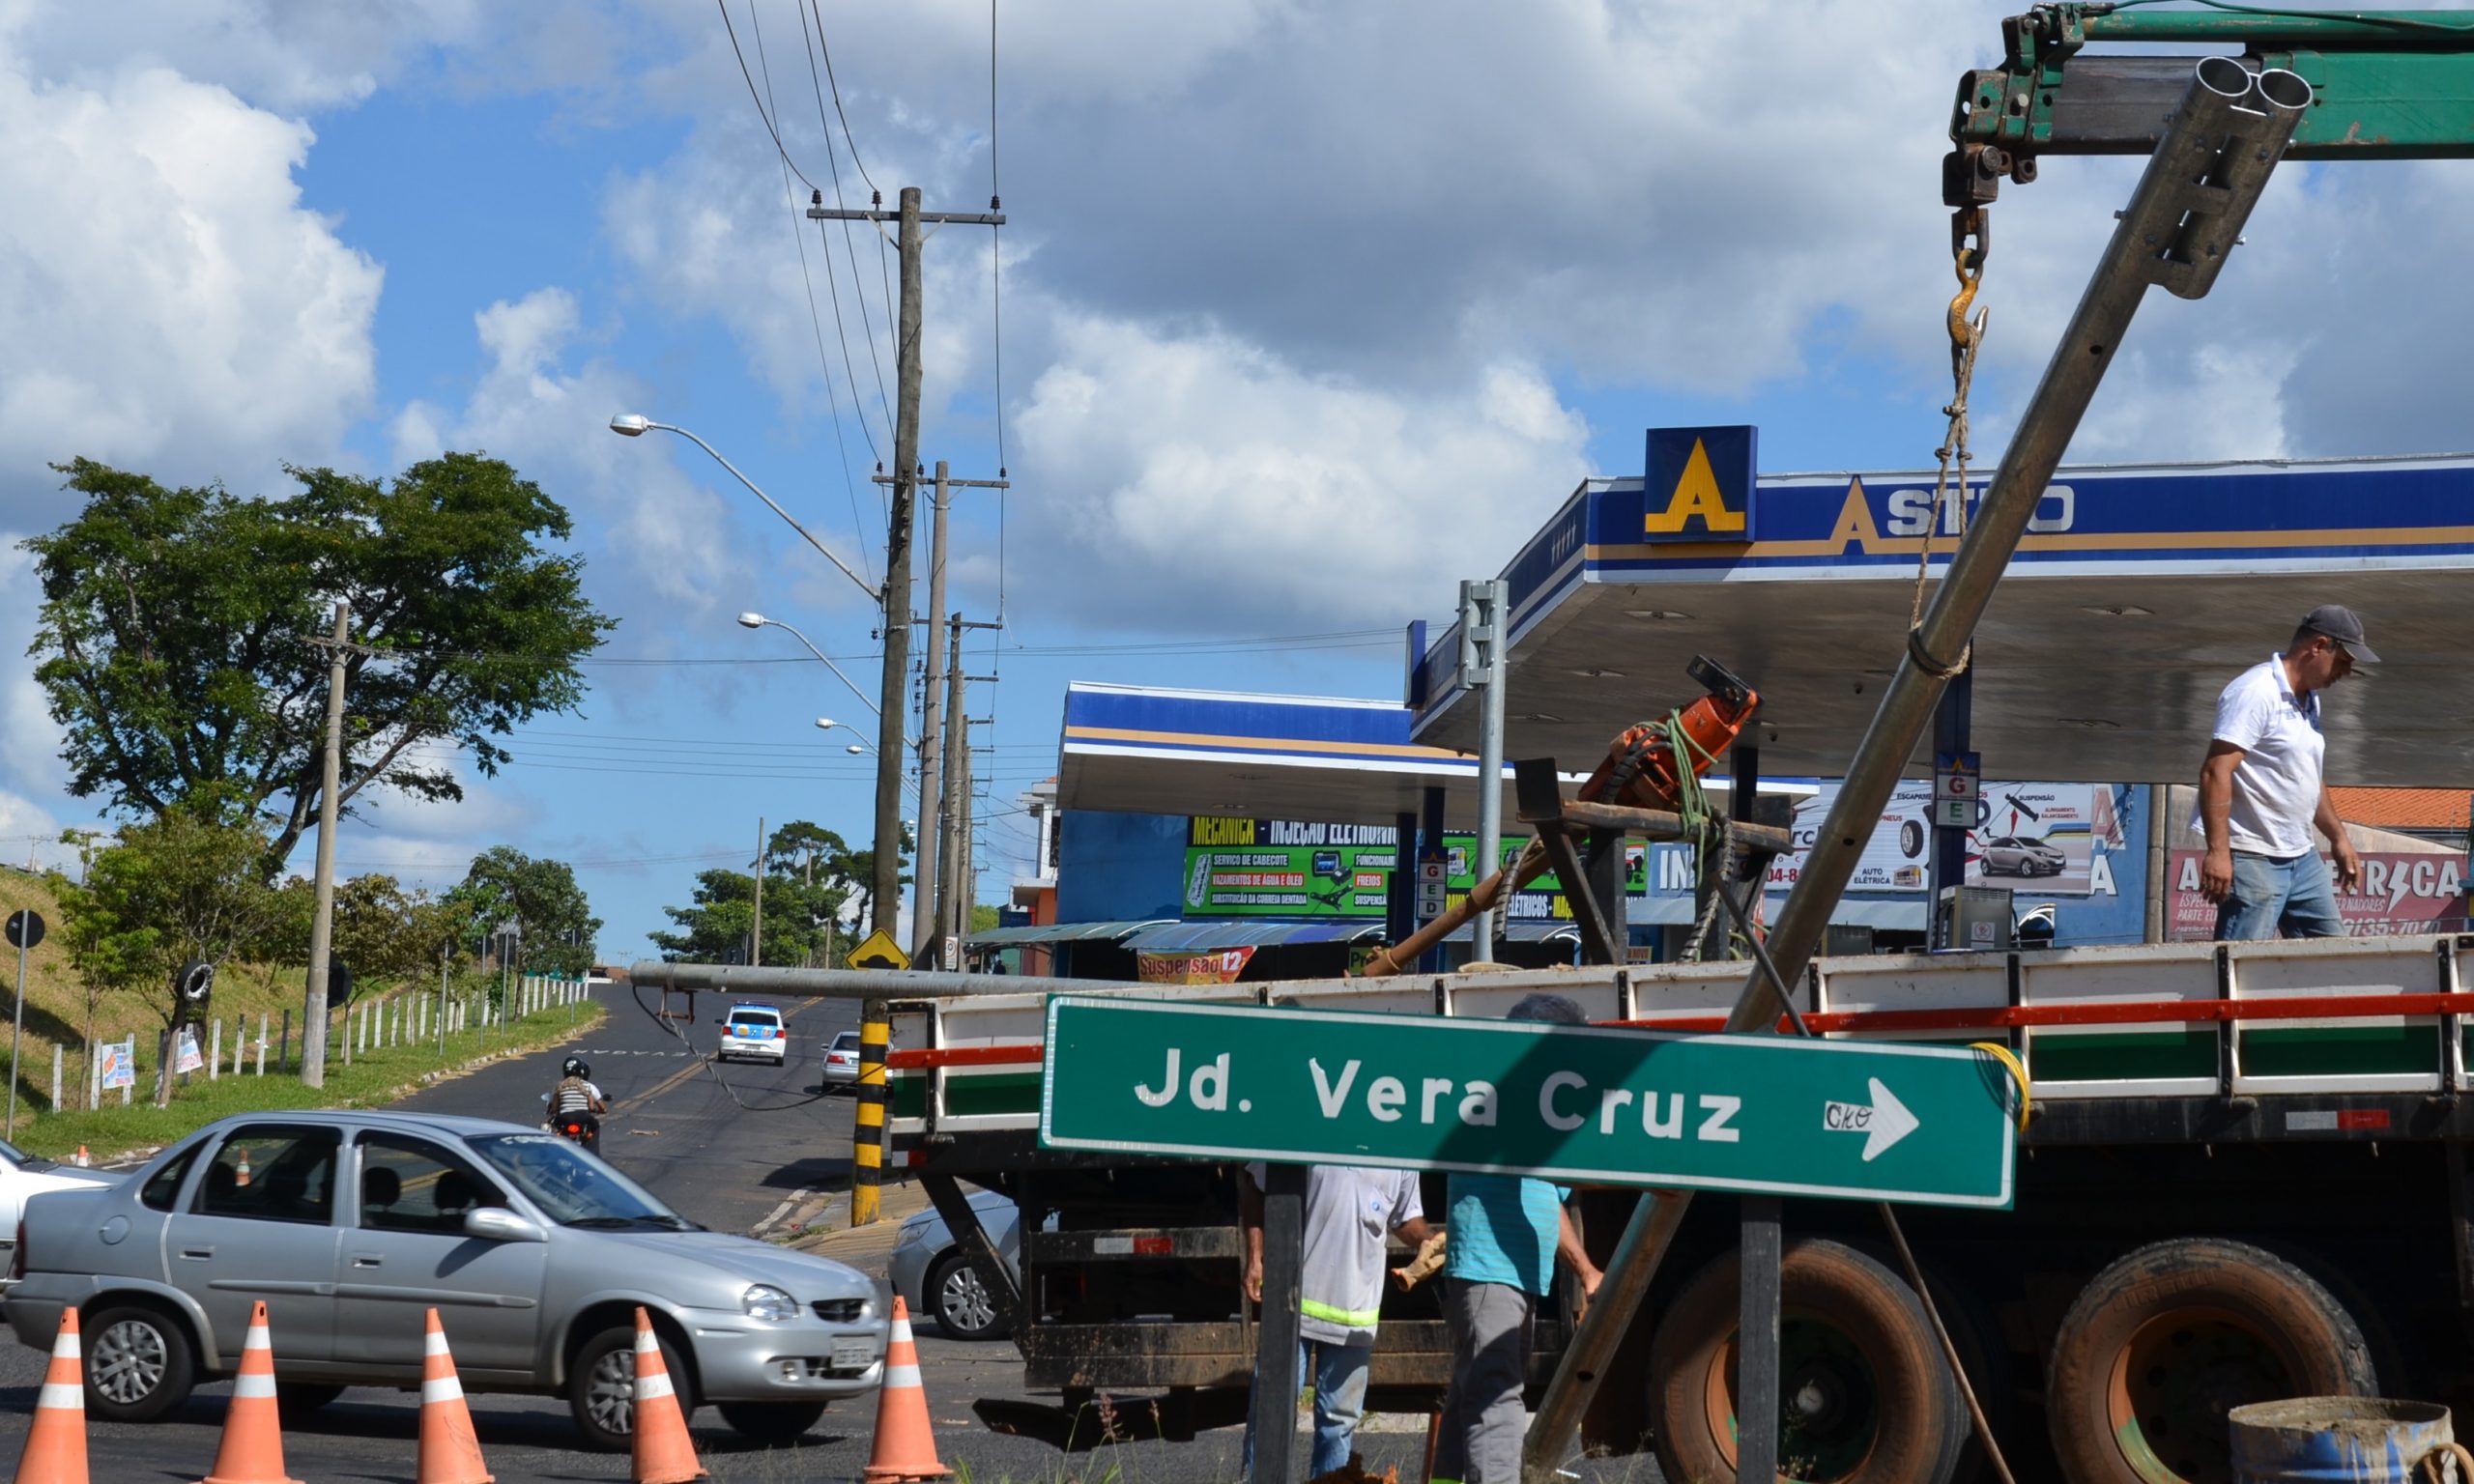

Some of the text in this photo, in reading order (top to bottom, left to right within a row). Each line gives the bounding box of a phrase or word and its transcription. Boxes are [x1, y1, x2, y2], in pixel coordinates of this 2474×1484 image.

[1829, 477, 2075, 555] ASTO
[1949, 777, 1966, 793] G
[1950, 803, 1963, 817] E
[1242, 854, 1251, 866] DE
[1212, 874, 1251, 885] VAZAMENTOS
[1252, 874, 1261, 885] DE
[1286, 873, 1304, 885] ÓLEO
[1356, 874, 1381, 887] FREIOS
[1854, 876, 1890, 885] ELÉTRICA
[2176, 909, 2203, 921] PARTE
[1139, 955, 1220, 976] Suspensão
[1134, 1047, 1742, 1143] Jd. Vera Cruz
